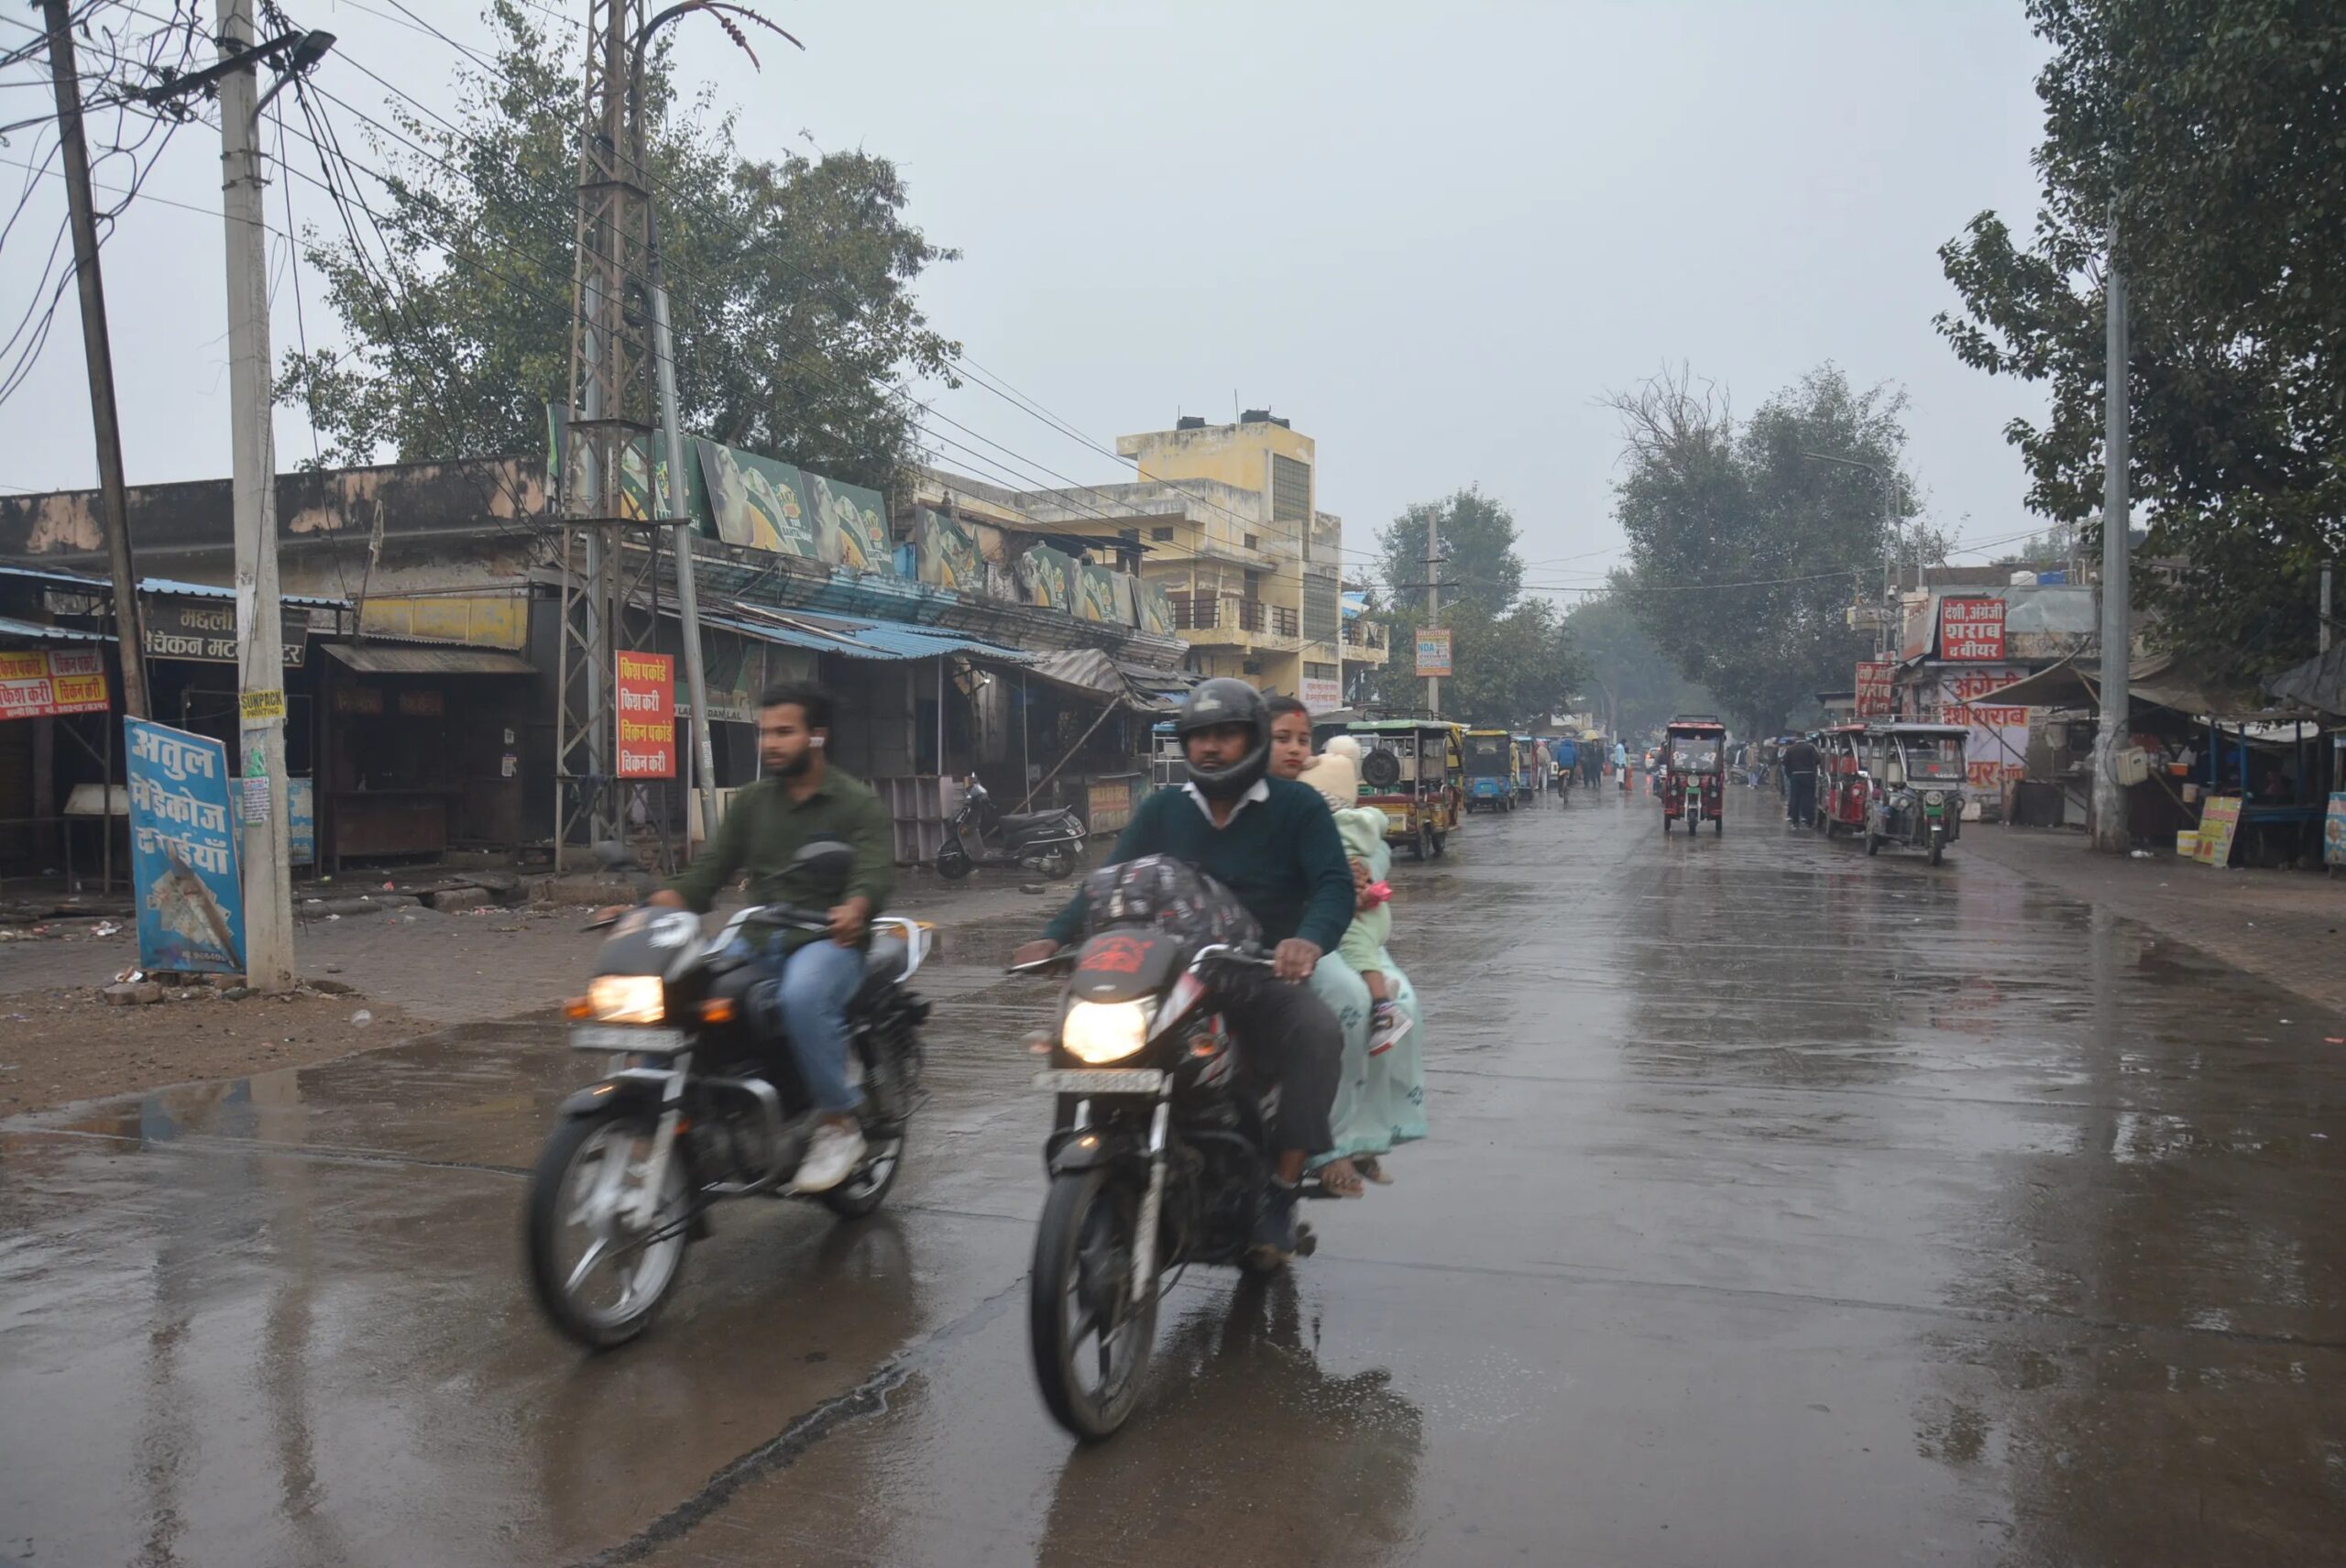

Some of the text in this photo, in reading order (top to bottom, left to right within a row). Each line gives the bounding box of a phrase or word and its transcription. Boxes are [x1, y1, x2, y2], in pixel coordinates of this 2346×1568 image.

[1946, 623, 2002, 639] शराब
[1960, 641, 1999, 657] बीयर
[620, 656, 641, 680] फिश
[26, 681, 50, 703] करी
[241, 690, 283, 710] SUNPACK
[620, 688, 660, 711] फिश करी
[247, 707, 280, 718] PRINTING
[1972, 707, 2028, 726] शराब
[620, 718, 647, 741] चिकन
[131, 728, 215, 781] अतुल
[621, 750, 666, 773] चिकन करी
